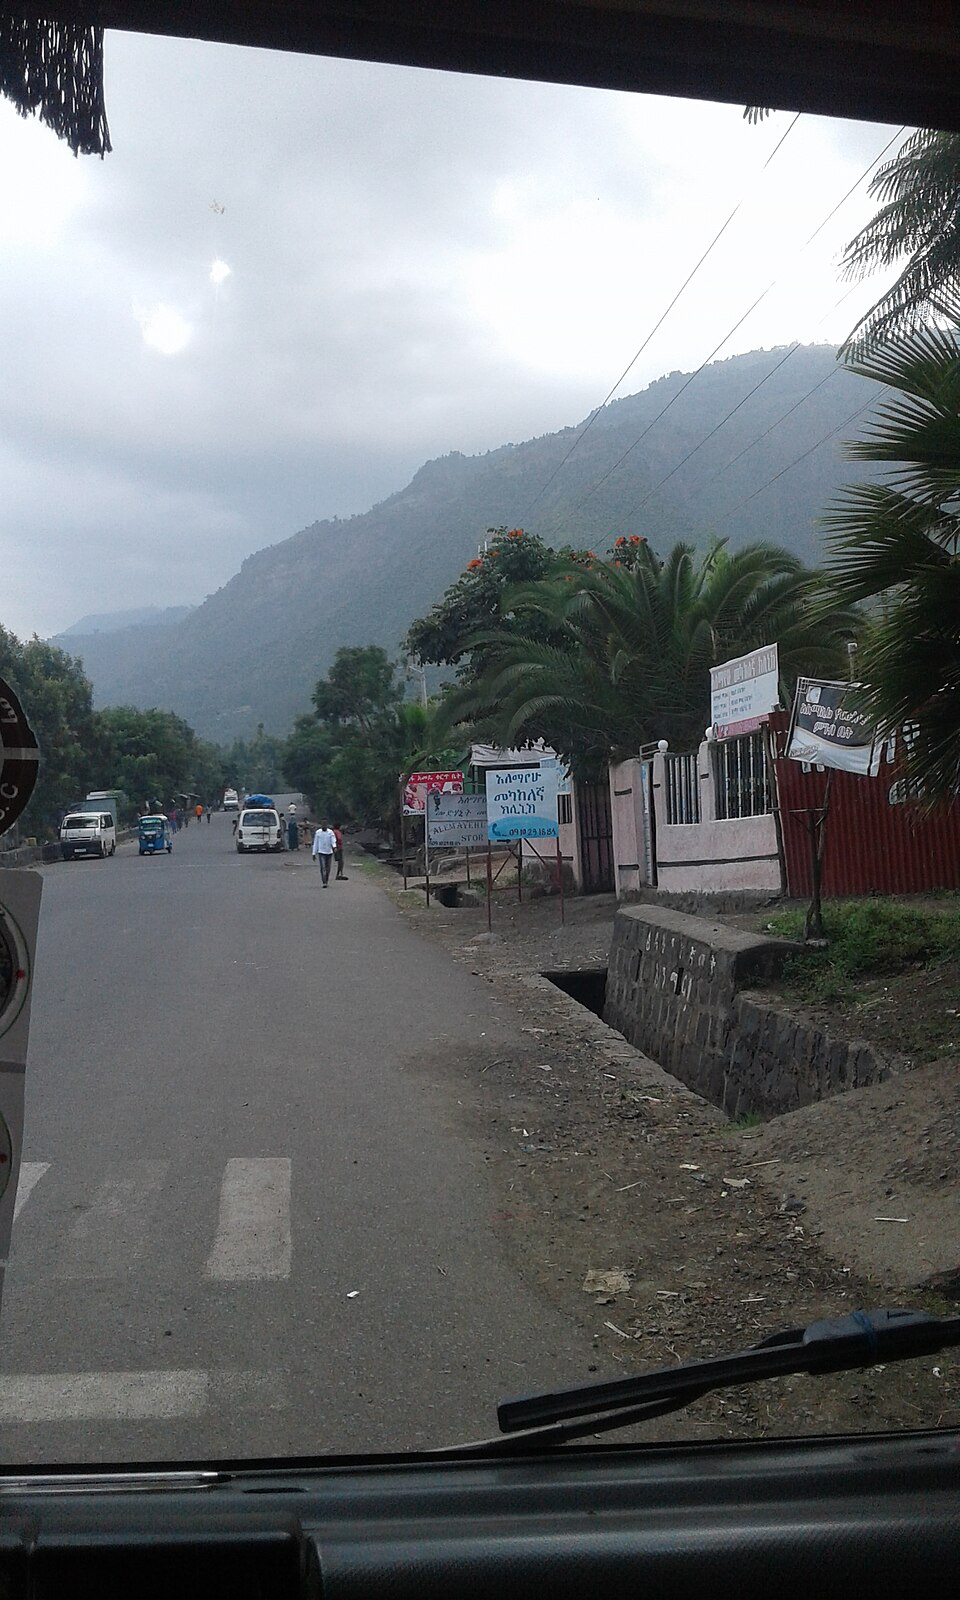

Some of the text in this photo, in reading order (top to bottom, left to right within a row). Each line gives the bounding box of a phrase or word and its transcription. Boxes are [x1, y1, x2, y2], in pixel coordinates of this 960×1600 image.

[496, 772, 542, 785] አለማየሁ
[494, 786, 545, 802] መካከለኛ
[500, 803, 536, 815] ክሊኒክ
